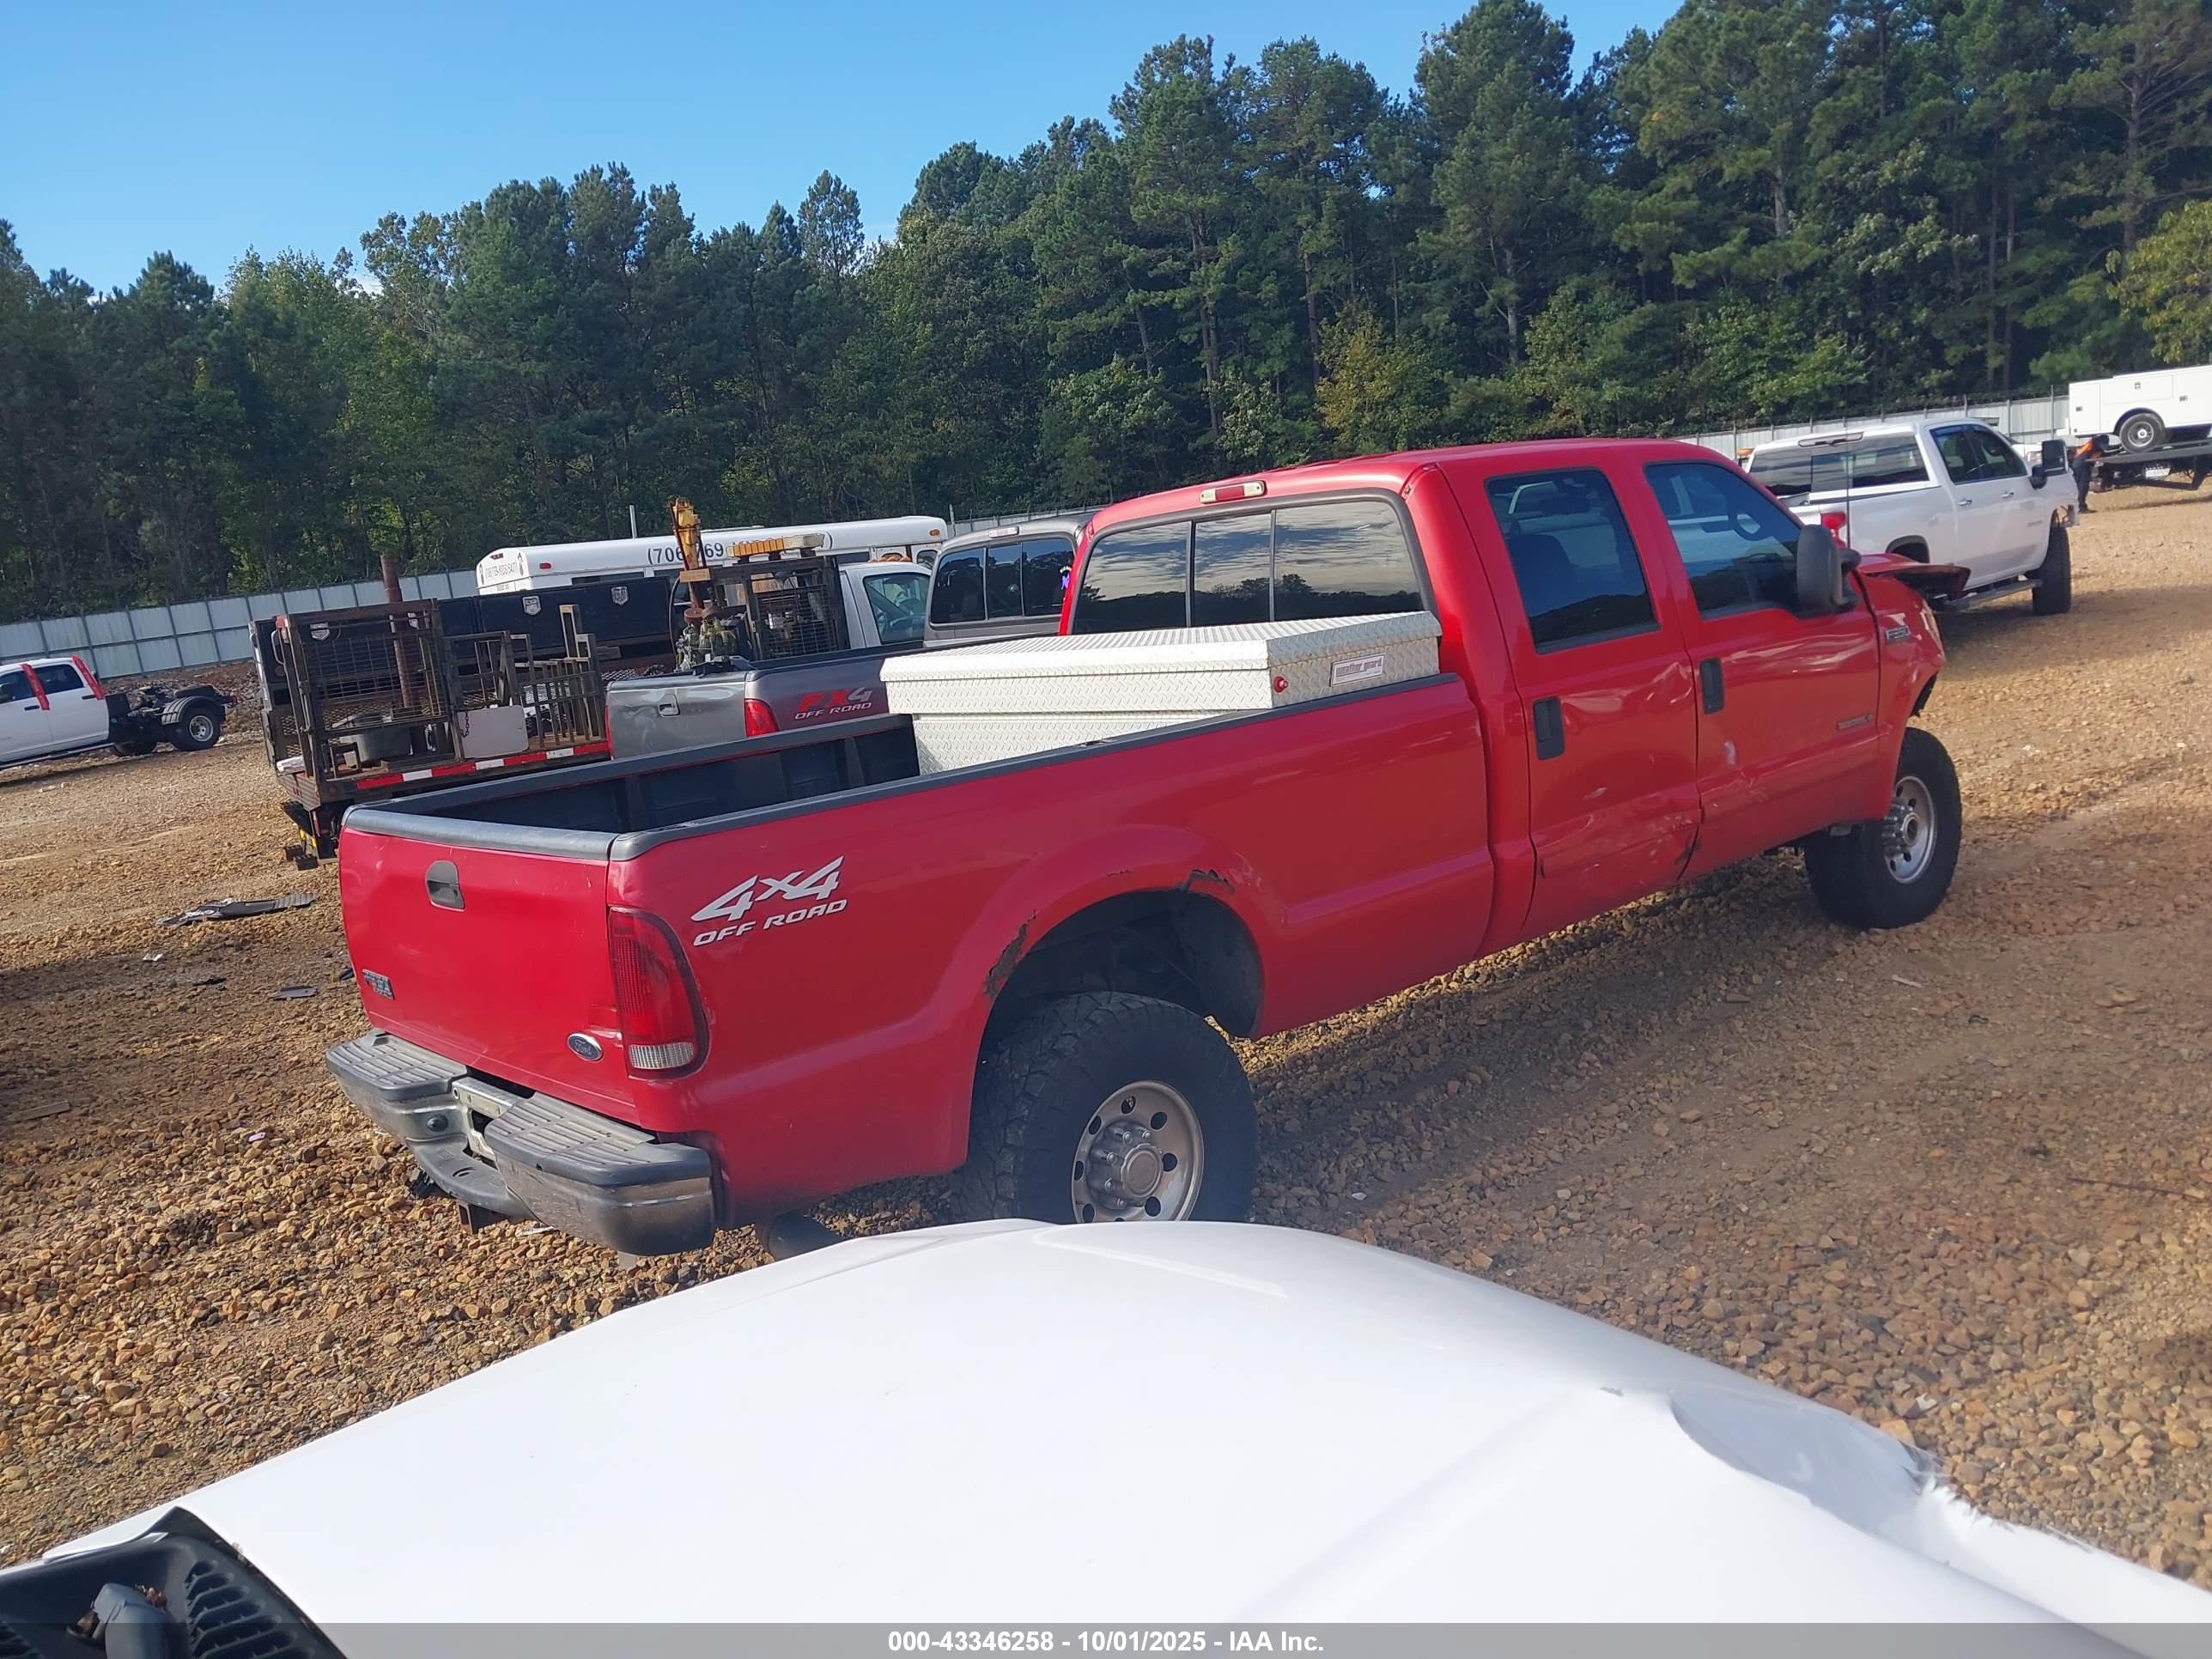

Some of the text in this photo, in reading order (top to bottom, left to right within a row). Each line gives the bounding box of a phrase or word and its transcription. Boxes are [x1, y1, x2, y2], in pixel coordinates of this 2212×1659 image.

[794, 702, 872, 720] OFF ROAD
[798, 687, 873, 713] FX4
[693, 899, 848, 947] OFF ROAD
[574, 1038, 592, 1055] Ford
